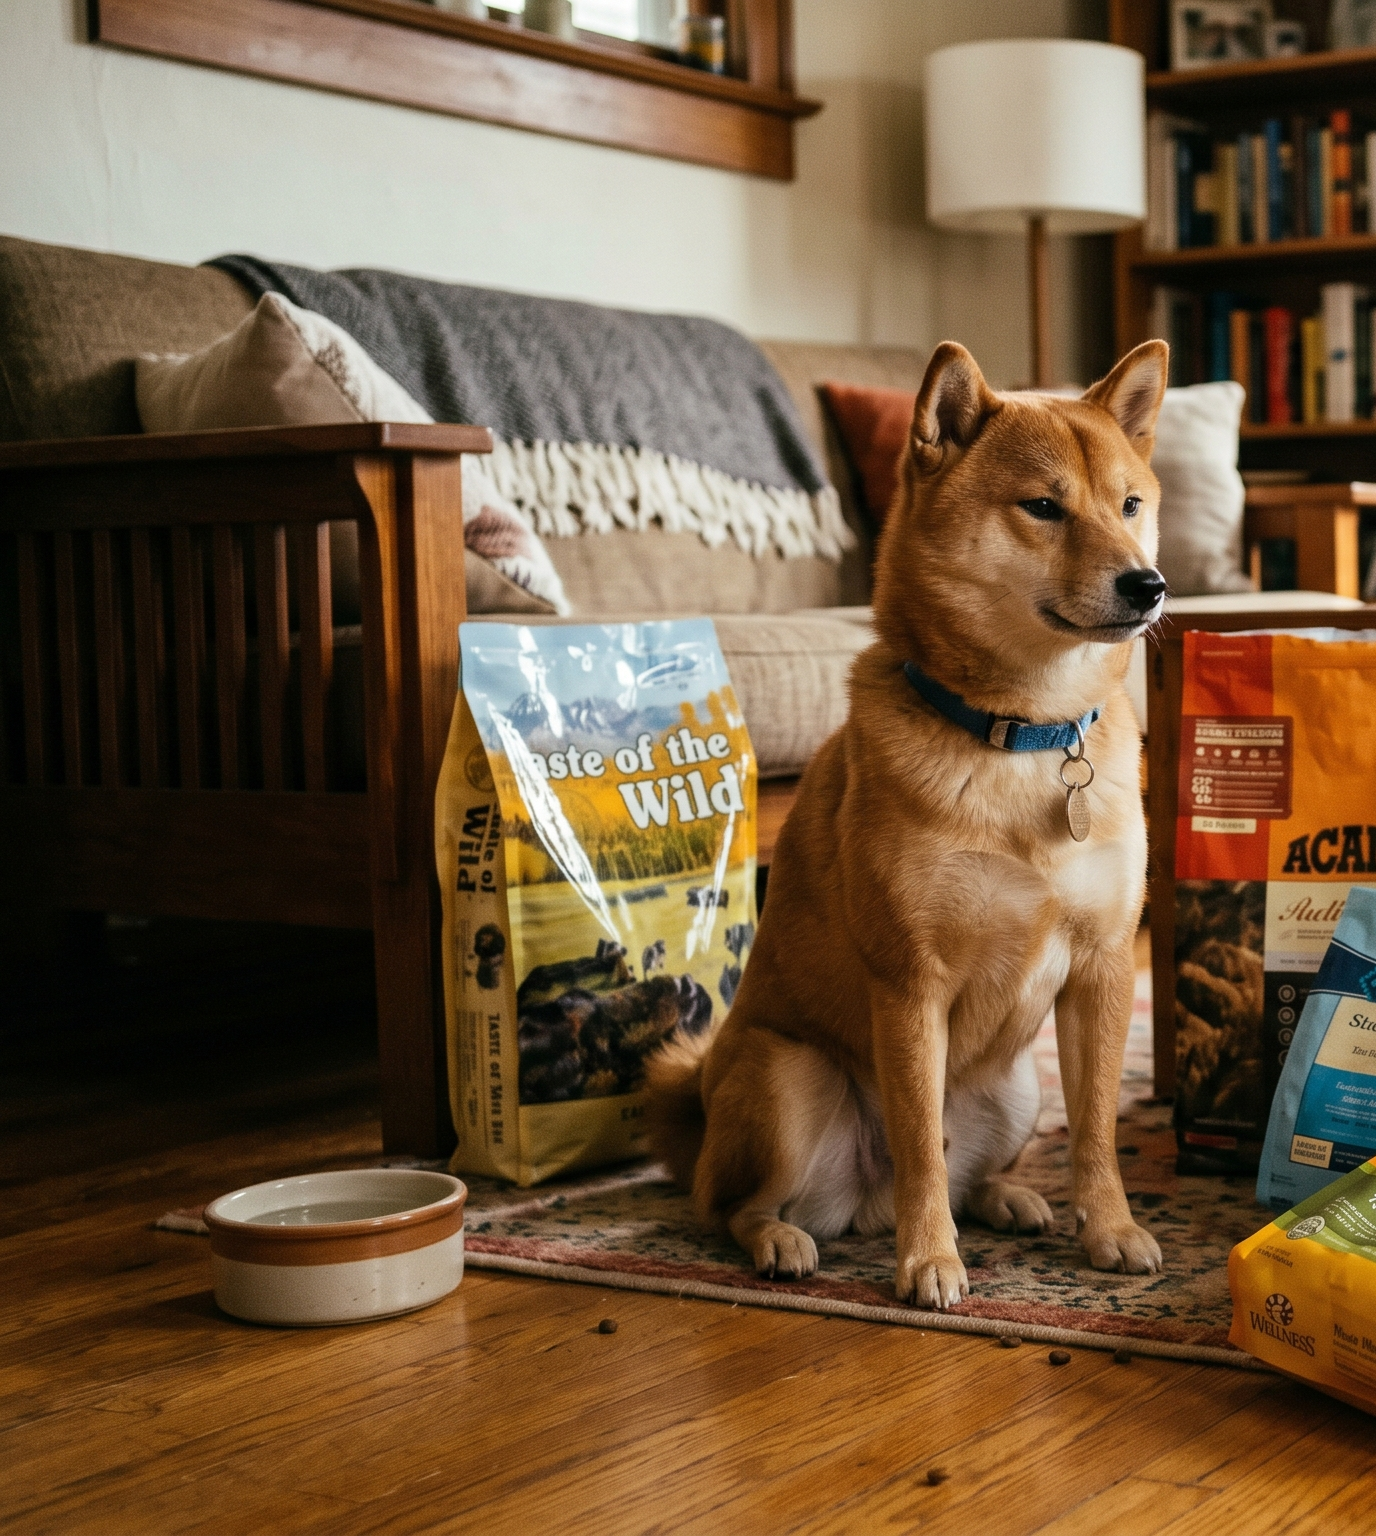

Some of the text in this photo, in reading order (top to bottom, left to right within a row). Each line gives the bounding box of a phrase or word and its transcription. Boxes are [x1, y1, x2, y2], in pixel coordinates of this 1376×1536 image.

[529, 727, 731, 780] aste of the
[618, 763, 745, 830] Wild
[457, 804, 490, 892] Wild
[1249, 1311, 1315, 1357] WELLNESS
